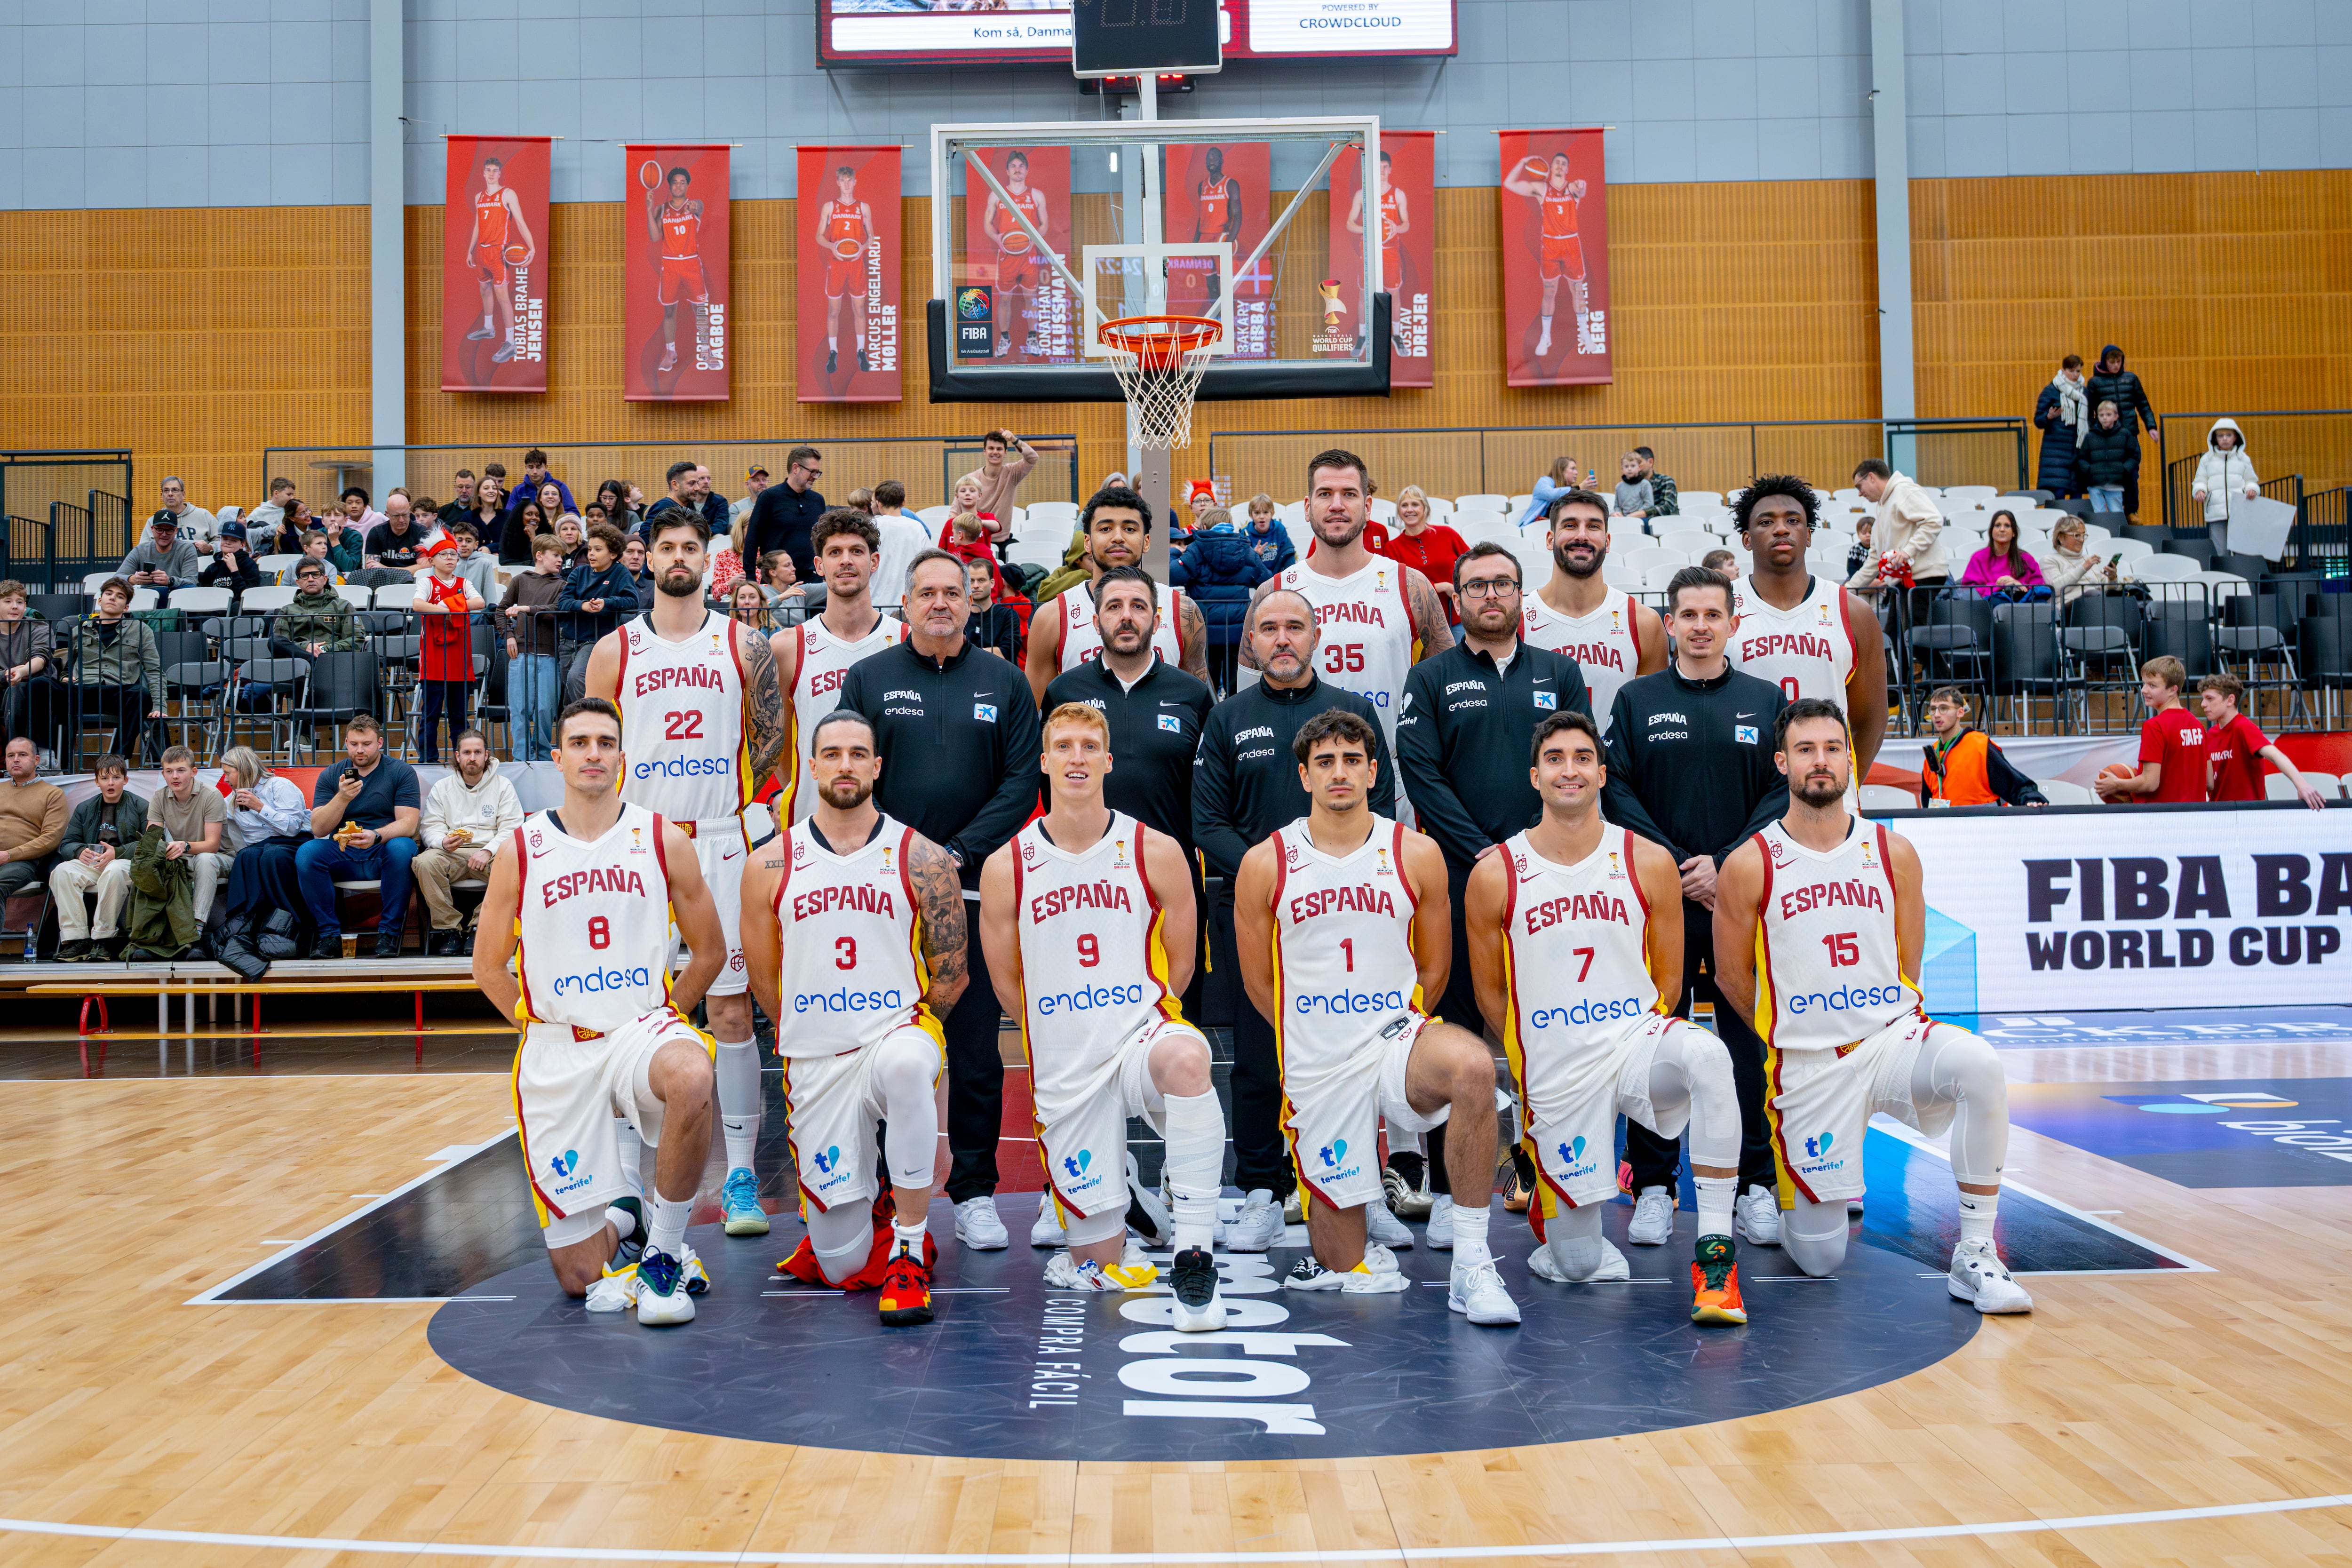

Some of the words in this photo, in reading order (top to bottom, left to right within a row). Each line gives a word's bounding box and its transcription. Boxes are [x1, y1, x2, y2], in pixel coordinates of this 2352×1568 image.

[974, 27, 1002, 38] Kom
[1028, 27, 1072, 37] Danma
[1300, 17, 1401, 29] CROWDCLOUD
[483, 210, 490, 220] 7
[663, 214, 693, 224] DANMARK
[1208, 203, 1214, 212] 0
[1557, 205, 1563, 215] 3
[673, 225, 686, 236] 10
[844, 221, 850, 231] 2
[515, 267, 528, 311] BRAHE
[514, 315, 526, 362] TOBIAS
[527, 298, 542, 362] JENSEN
[882, 305, 897, 371] MØLLER
[962, 327, 987, 339] FIBA
[1413, 293, 1428, 357] DREJER
[869, 318, 881, 371] MARCUS
[1312, 343, 1353, 352] QUALIFIERS
[176, 526, 196, 541] AP
[1316, 601, 1385, 629] SPAÑA
[1325, 643, 1364, 673] 35
[1742, 632, 1832, 662] ESPAÑA
[636, 664, 723, 697] ESPAÑA
[1446, 680, 1486, 695] ESPAÑA
[1780, 677, 1799, 704] 0
[883, 690, 922, 702] ESPAÑA
[1449, 699, 1487, 712] endesa
[665, 710, 703, 740] 22
[885, 707, 924, 716] endesa
[1648, 712, 1687, 726] ESPAÑA
[1235, 725, 1274, 745] ESPAÑA
[1648, 730, 1688, 742] endesa
[2180, 728, 2203, 746] STAFF
[635, 755, 729, 780] endesa
[1238, 748, 1275, 761] endesa
[543, 865, 645, 909] ESPAÑA
[1032, 879, 1132, 925] ESPAÑA
[1780, 879, 1884, 921] ESPAÑA
[2021, 855, 2233, 923] FIBA
[794, 883, 894, 922] ESPAÑA
[1291, 883, 1395, 925] ESPAÑA
[1526, 891, 1629, 936] ESPAÑA
[588, 916, 611, 950] 8
[2025, 928, 2214, 971] WORLD
[2230, 925, 2342, 966] CUP
[835, 936, 857, 970] 3
[1077, 933, 1100, 968] 9
[1339, 938, 1353, 972] 1
[1573, 947, 1595, 982] 7
[1821, 932, 1859, 967] 15
[554, 966, 649, 996] endesa
[795, 987, 902, 1013] endesa
[1039, 984, 1142, 1015] endesa
[1296, 988, 1404, 1014] endesa
[1532, 997, 1642, 1029] endesa
[1789, 984, 1901, 1014] endesa
[1037, 1298, 1087, 1354] COMPRA
[1029, 1361, 1092, 1409] FÁCIL
